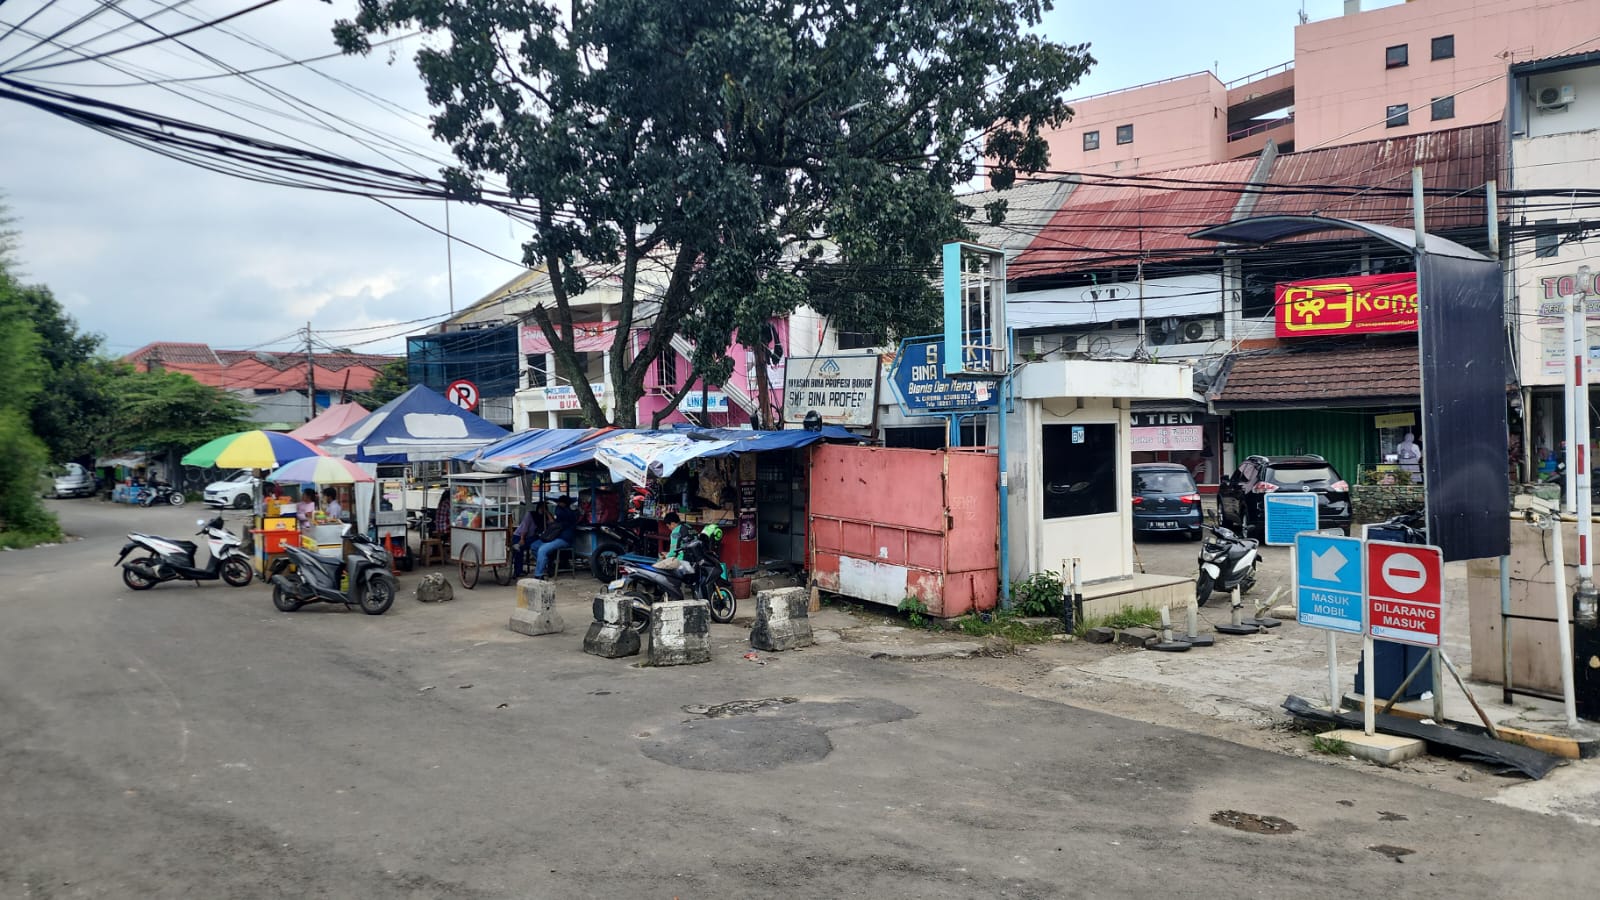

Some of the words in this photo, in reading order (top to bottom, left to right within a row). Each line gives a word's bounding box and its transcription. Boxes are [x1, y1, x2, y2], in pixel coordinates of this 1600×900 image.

[1541, 273, 1600, 299] TO
[912, 365, 937, 381] BINA
[825, 379, 850, 388] PROFESI
[852, 379, 873, 388] BOGOR
[908, 382, 932, 394] Bisnis
[934, 381, 950, 393] Dan
[458, 387, 470, 405] P
[808, 392, 826, 406] BINA
[559, 400, 578, 409] BUK
[1147, 413, 1193, 425] TIEN
[1311, 592, 1350, 606] MASUK
[1313, 604, 1348, 617] MOBIL
[1373, 602, 1436, 619] DILARANG
[1383, 615, 1426, 631] MASUK
